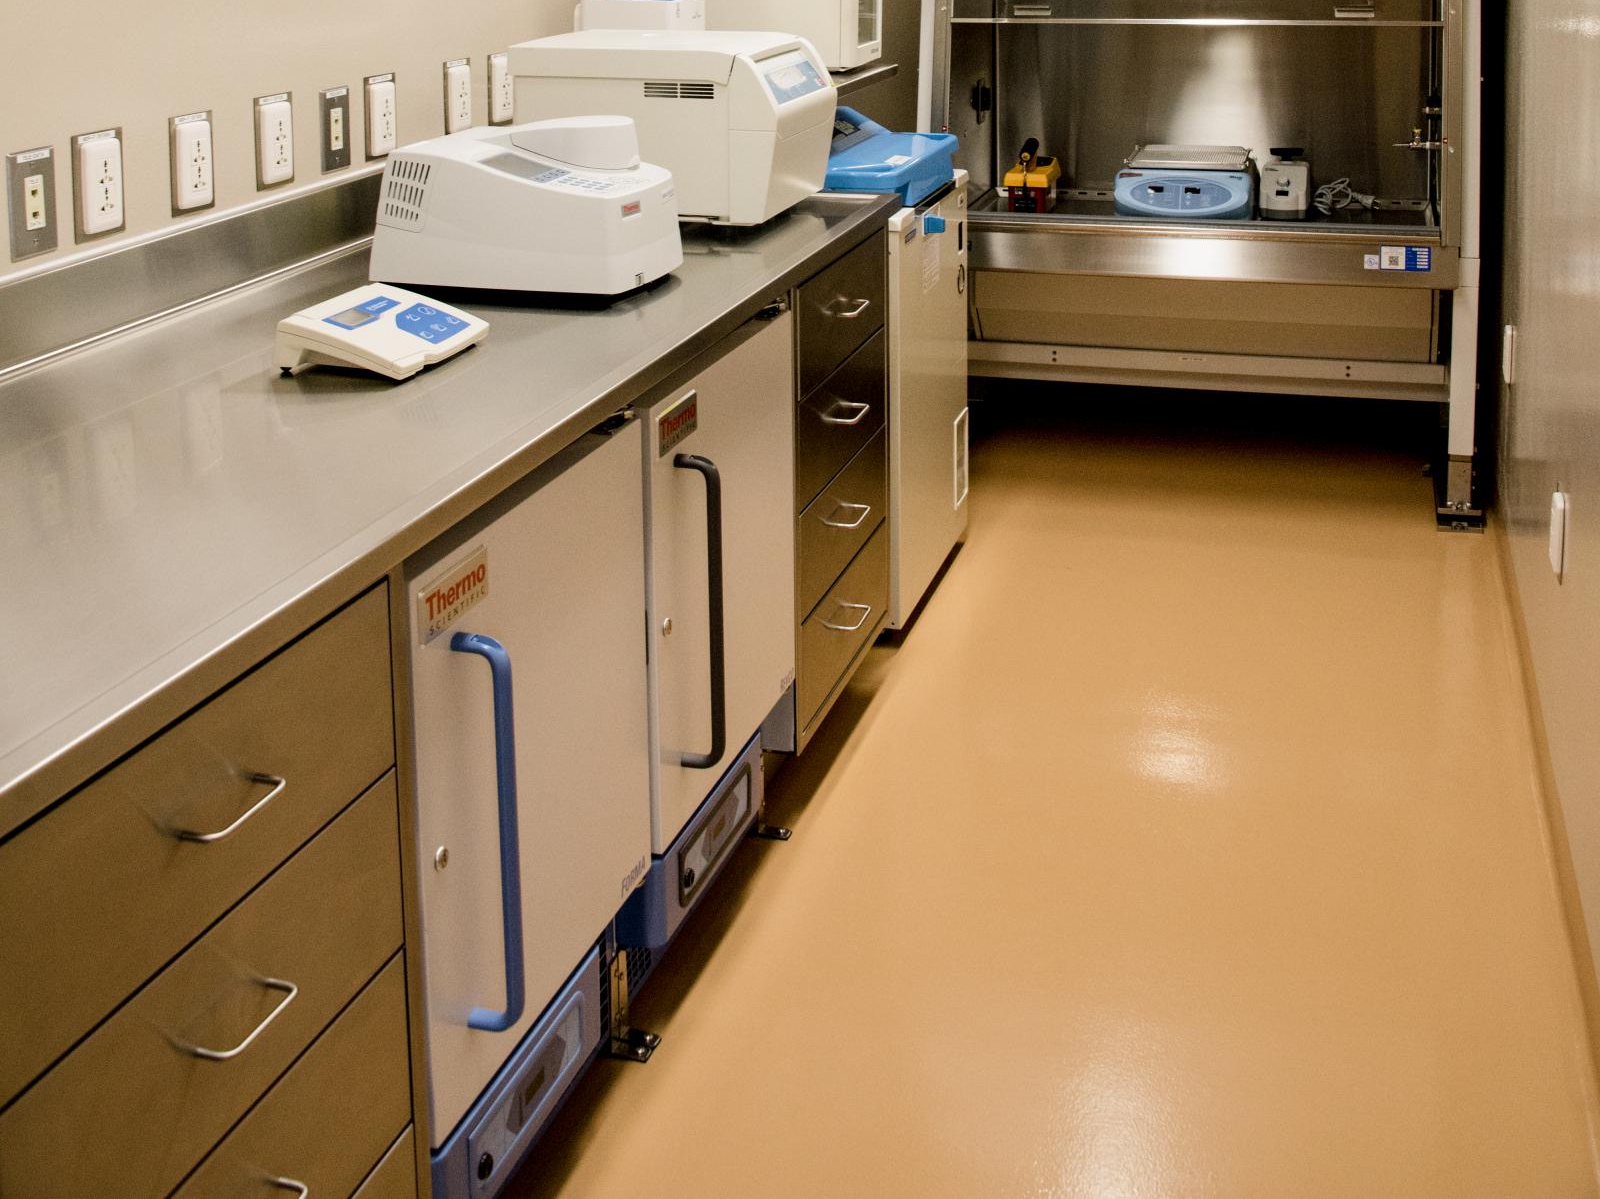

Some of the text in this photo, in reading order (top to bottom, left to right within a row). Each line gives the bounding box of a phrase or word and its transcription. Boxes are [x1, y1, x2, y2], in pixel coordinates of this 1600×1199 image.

[659, 402, 697, 442] Thermo
[425, 563, 486, 621] Thermo
[429, 585, 485, 636] SCIENTIFIC
[621, 855, 646, 899] FORMA
